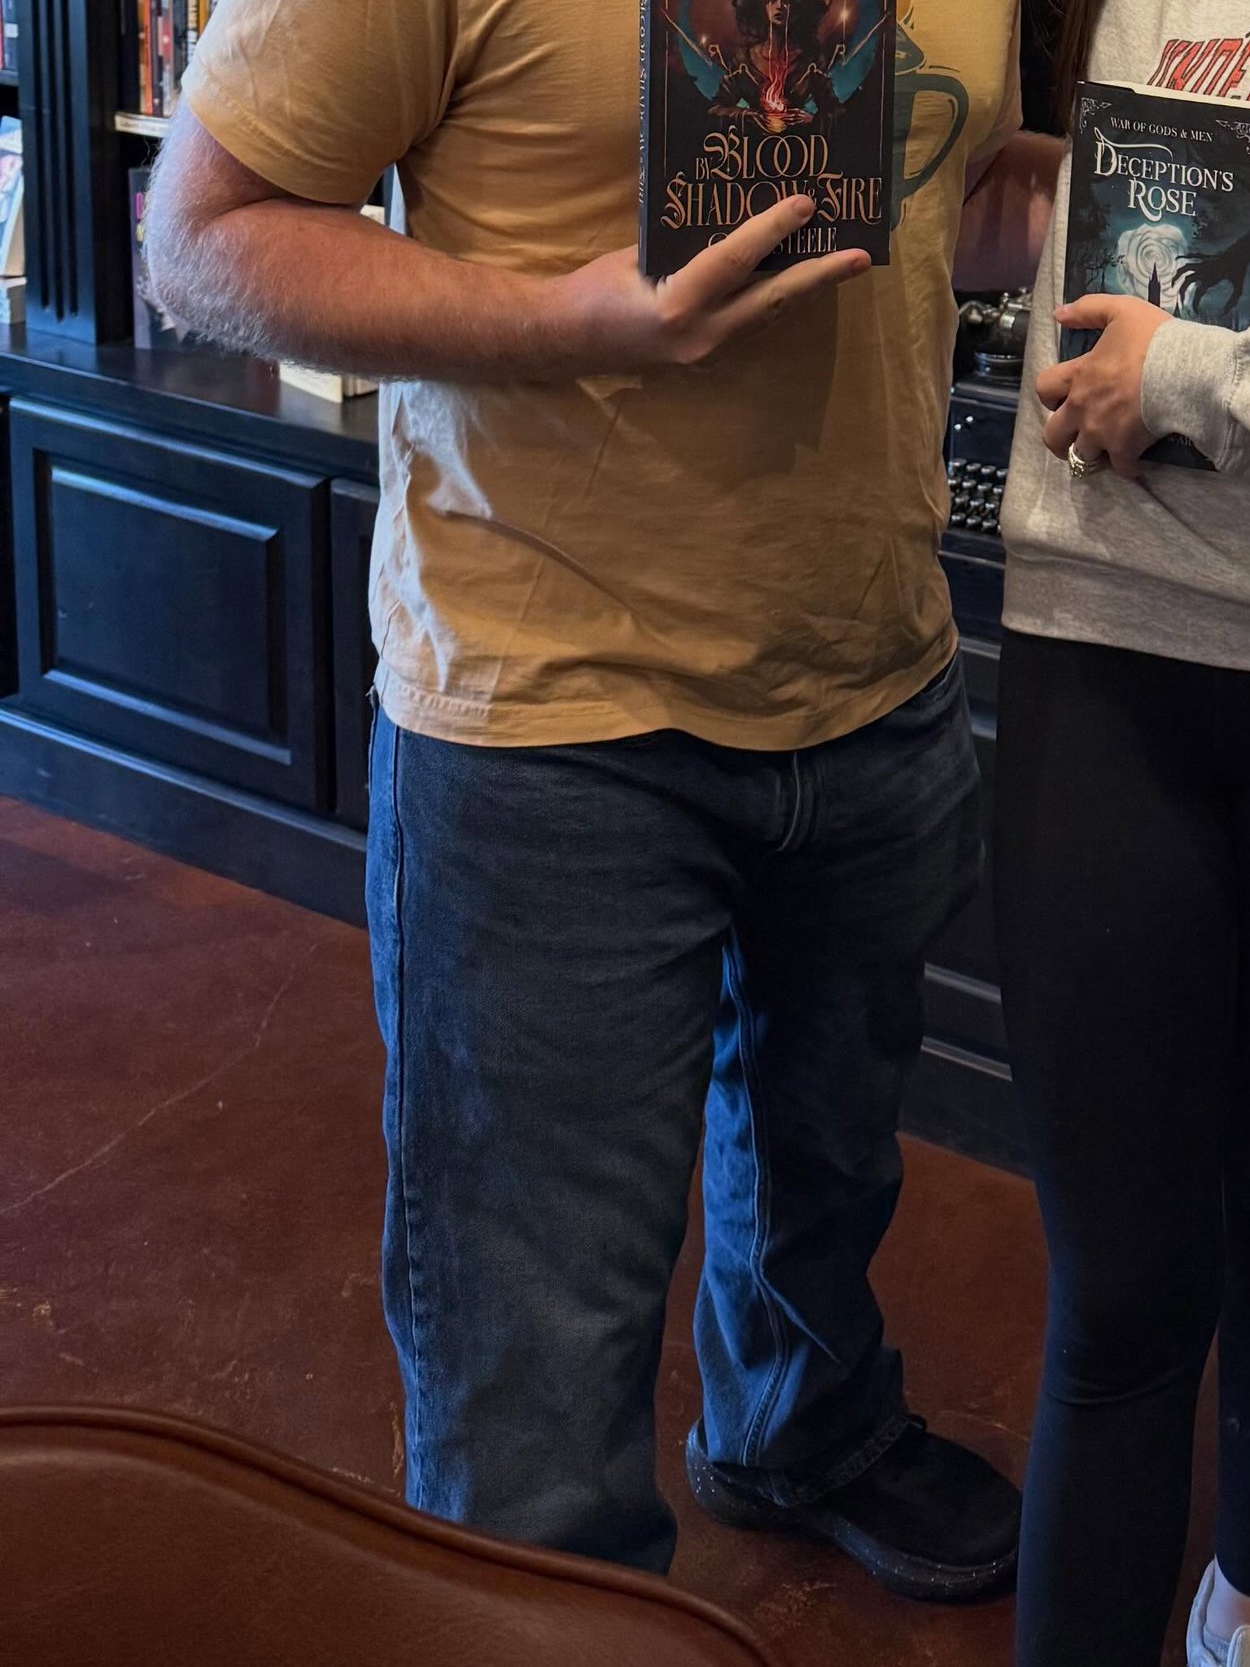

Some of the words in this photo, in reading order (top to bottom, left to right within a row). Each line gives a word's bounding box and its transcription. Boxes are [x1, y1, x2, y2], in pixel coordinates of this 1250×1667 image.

[703, 124, 829, 181] BLOOD
[1110, 117, 1131, 130] WAR
[1133, 121, 1147, 132] OF
[1149, 124, 1178, 137] GODS
[1190, 130, 1214, 143] MEN
[695, 156, 714, 181] BY
[1093, 127, 1235, 192] DECEPTION'S
[660, 171, 808, 230] SHADOW
[816, 170, 883, 226] FIRE
[1127, 177, 1198, 222] ROSE
[773, 227, 838, 254] STEELE
